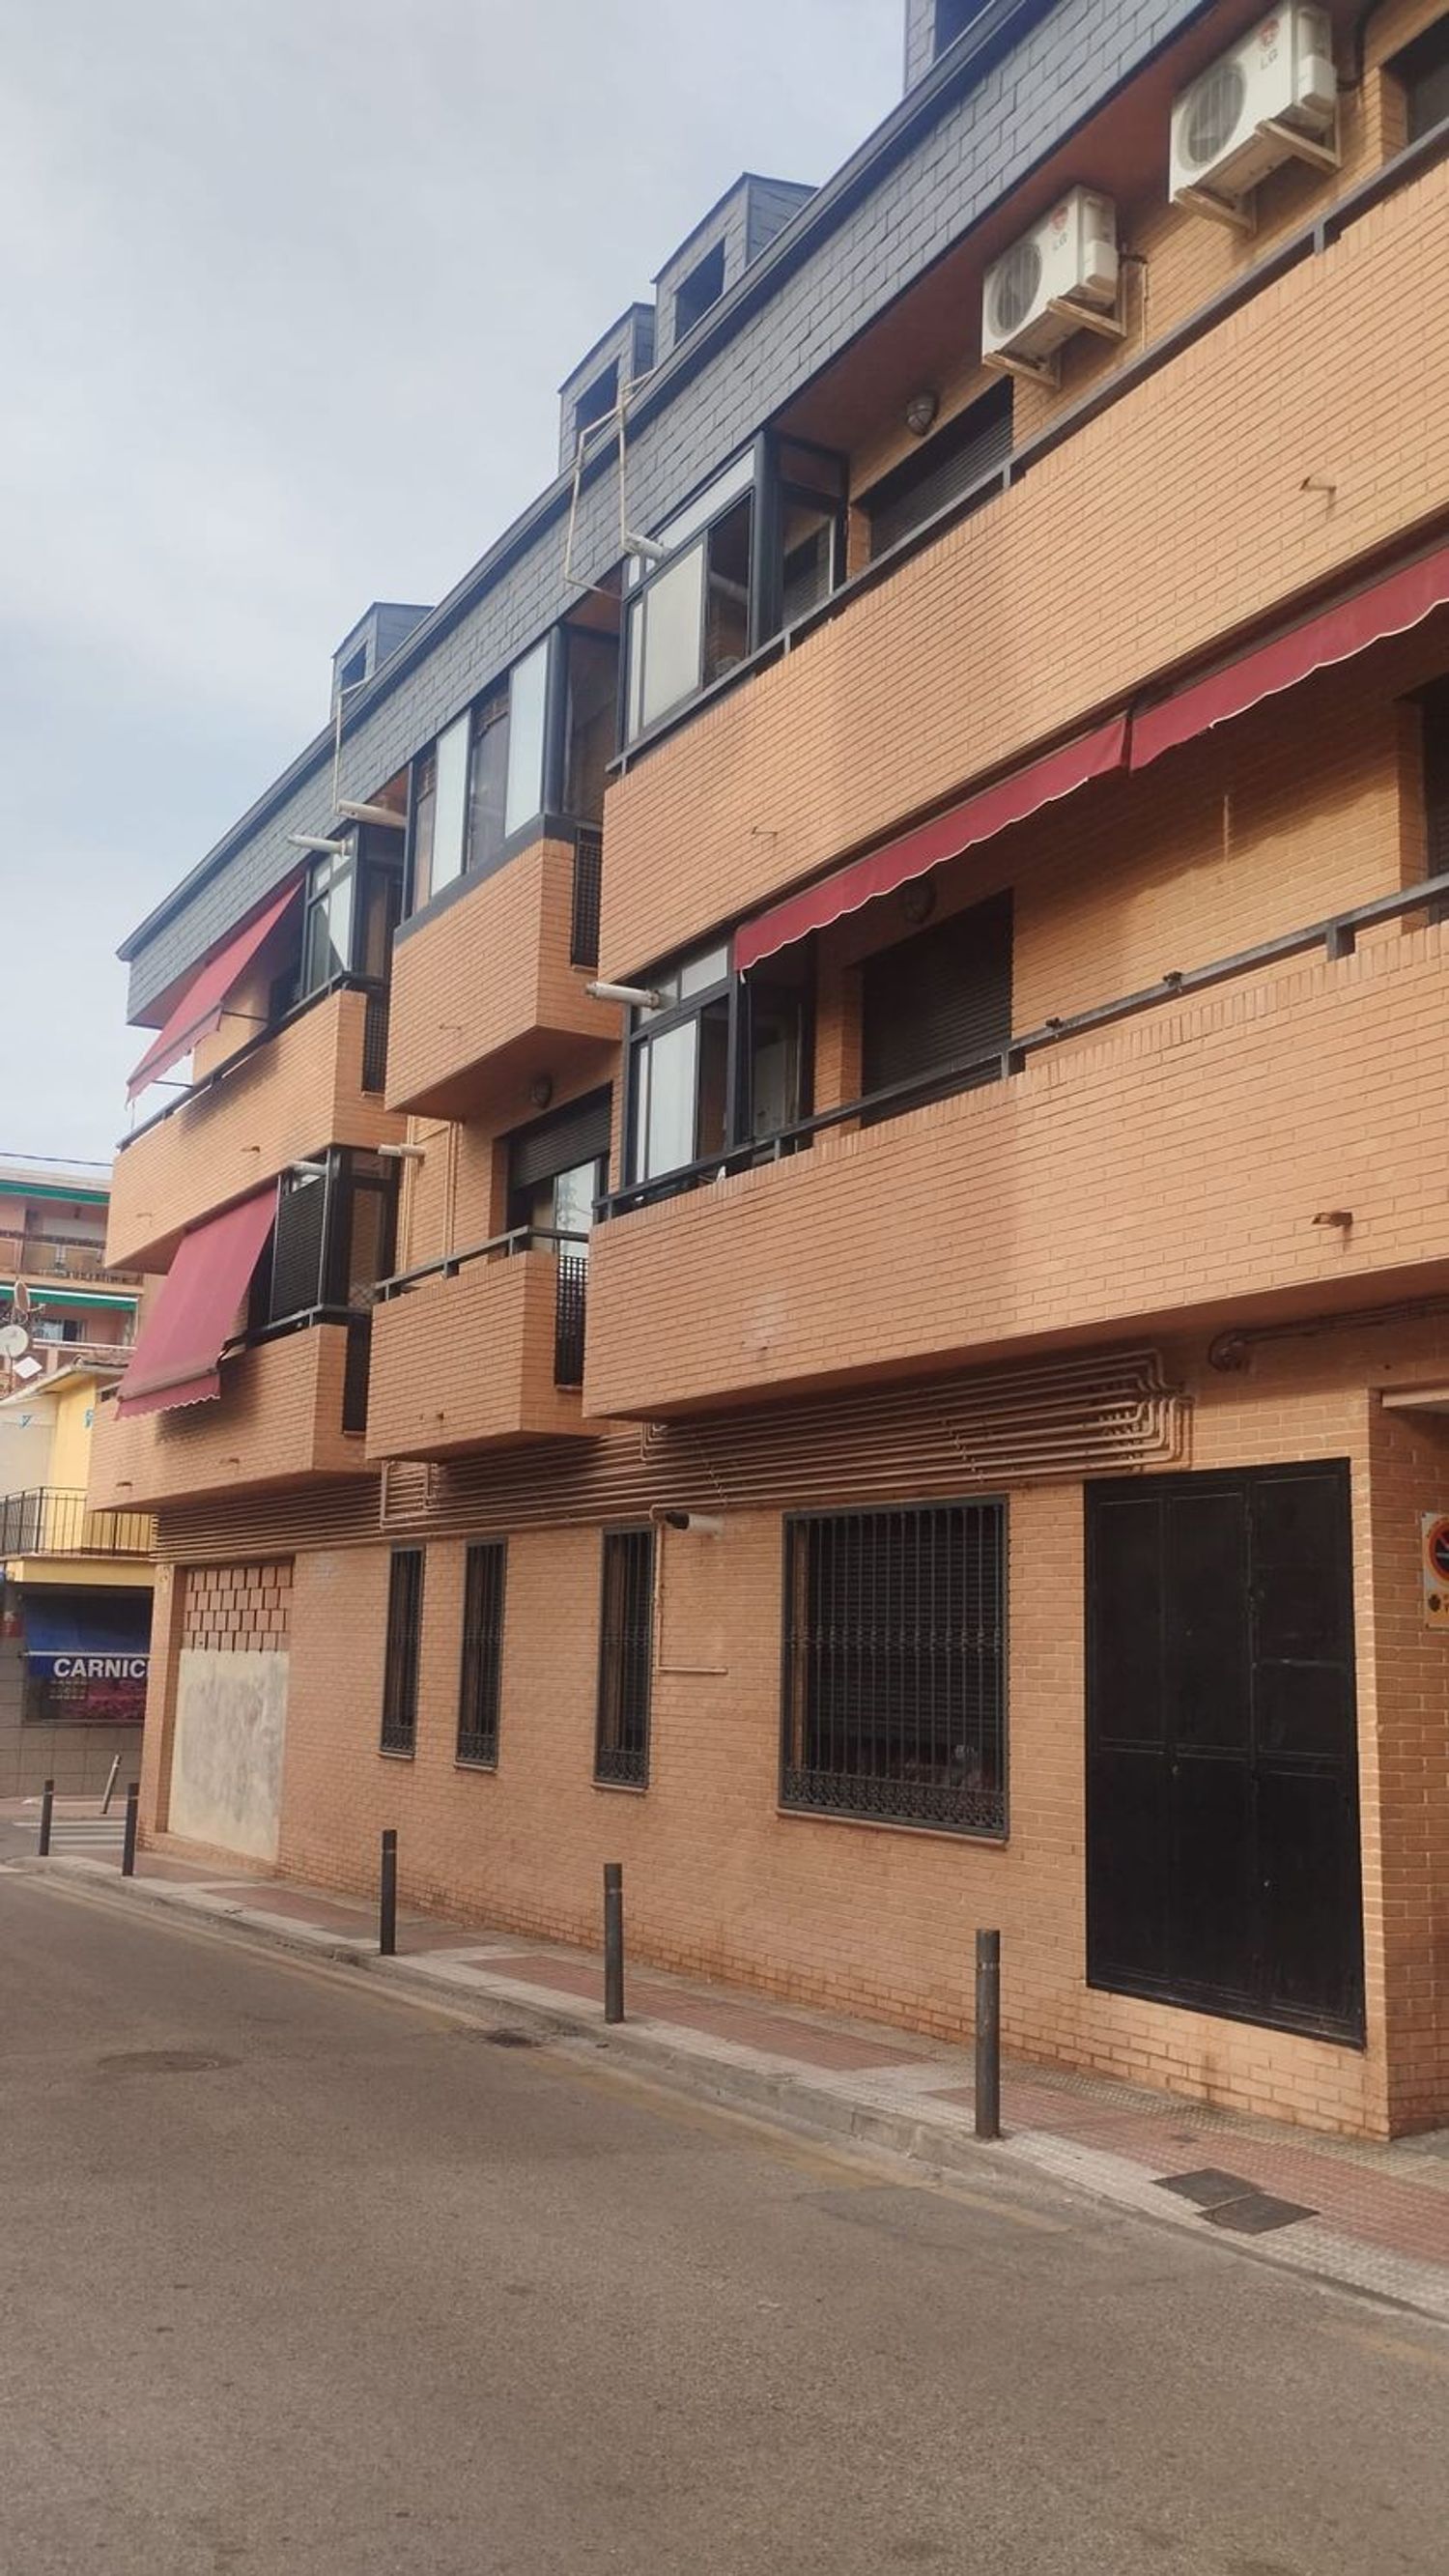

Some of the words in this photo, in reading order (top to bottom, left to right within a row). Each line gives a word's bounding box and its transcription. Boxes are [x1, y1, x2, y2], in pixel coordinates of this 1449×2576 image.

[1260, 47, 1279, 71] LG
[1052, 231, 1068, 251] LG
[53, 1658, 150, 1677] CARNIC
